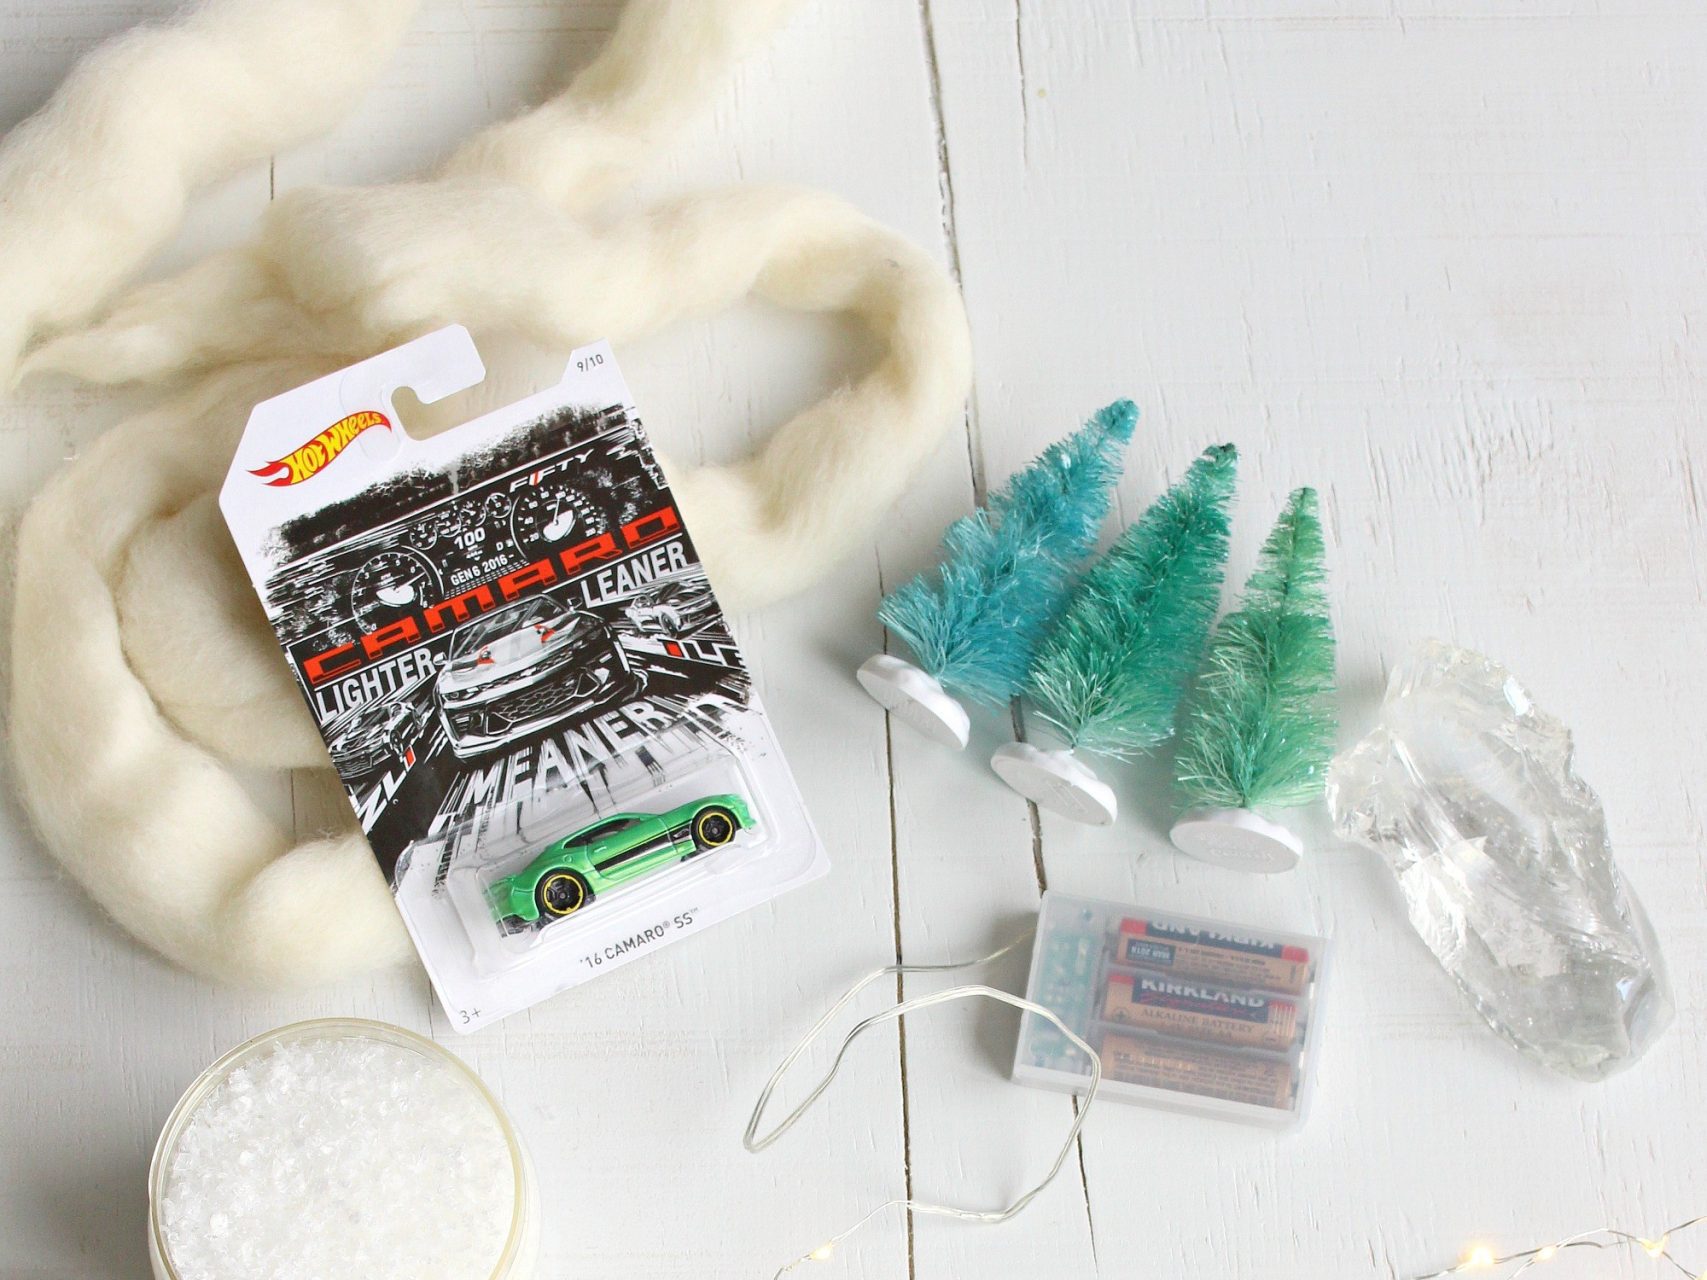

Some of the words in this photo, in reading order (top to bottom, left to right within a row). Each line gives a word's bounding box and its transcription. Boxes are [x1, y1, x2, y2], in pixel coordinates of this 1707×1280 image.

[575, 353, 605, 373] 9/10
[509, 448, 594, 493] FIFTY
[454, 527, 486, 550] 100
[482, 554, 508, 576] 2016
[580, 541, 688, 608] LEANER
[303, 506, 681, 684] CAMARO
[316, 648, 437, 722] LIGHTER
[440, 698, 680, 822] MEANER
[1142, 978, 1265, 1007] KIRKLAND
[459, 1007, 481, 1025] 3+
[1142, 1008, 1197, 1025] ALKALINE
[1201, 1016, 1254, 1034] BATTERY
